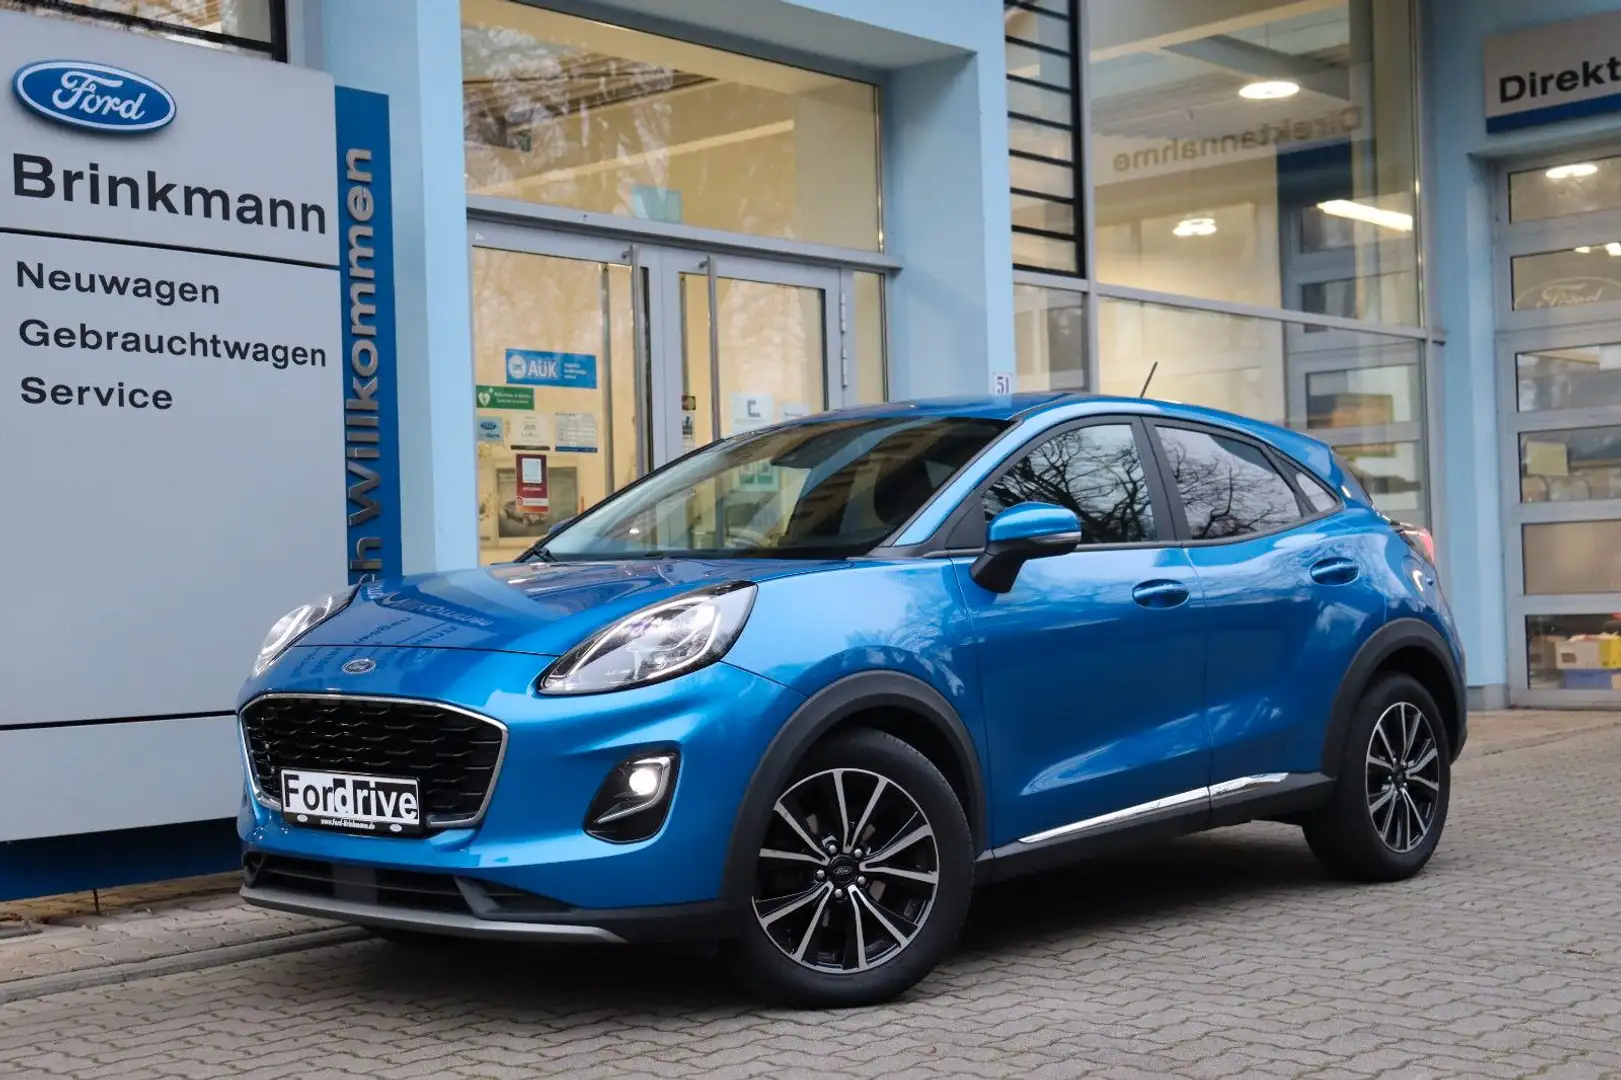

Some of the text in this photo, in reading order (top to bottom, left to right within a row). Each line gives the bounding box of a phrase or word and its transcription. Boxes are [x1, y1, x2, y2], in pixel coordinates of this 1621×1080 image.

[52, 70, 146, 121] Ford
[1499, 56, 1621, 104] Direkt
[13, 152, 327, 235] Brinkmann
[16, 261, 220, 306] Neuwagen
[19, 318, 327, 369] Gebrauchtwagen
[346, 148, 381, 527] Willkommen
[20, 376, 173, 410] Service
[283, 774, 418, 820] Fordrive
